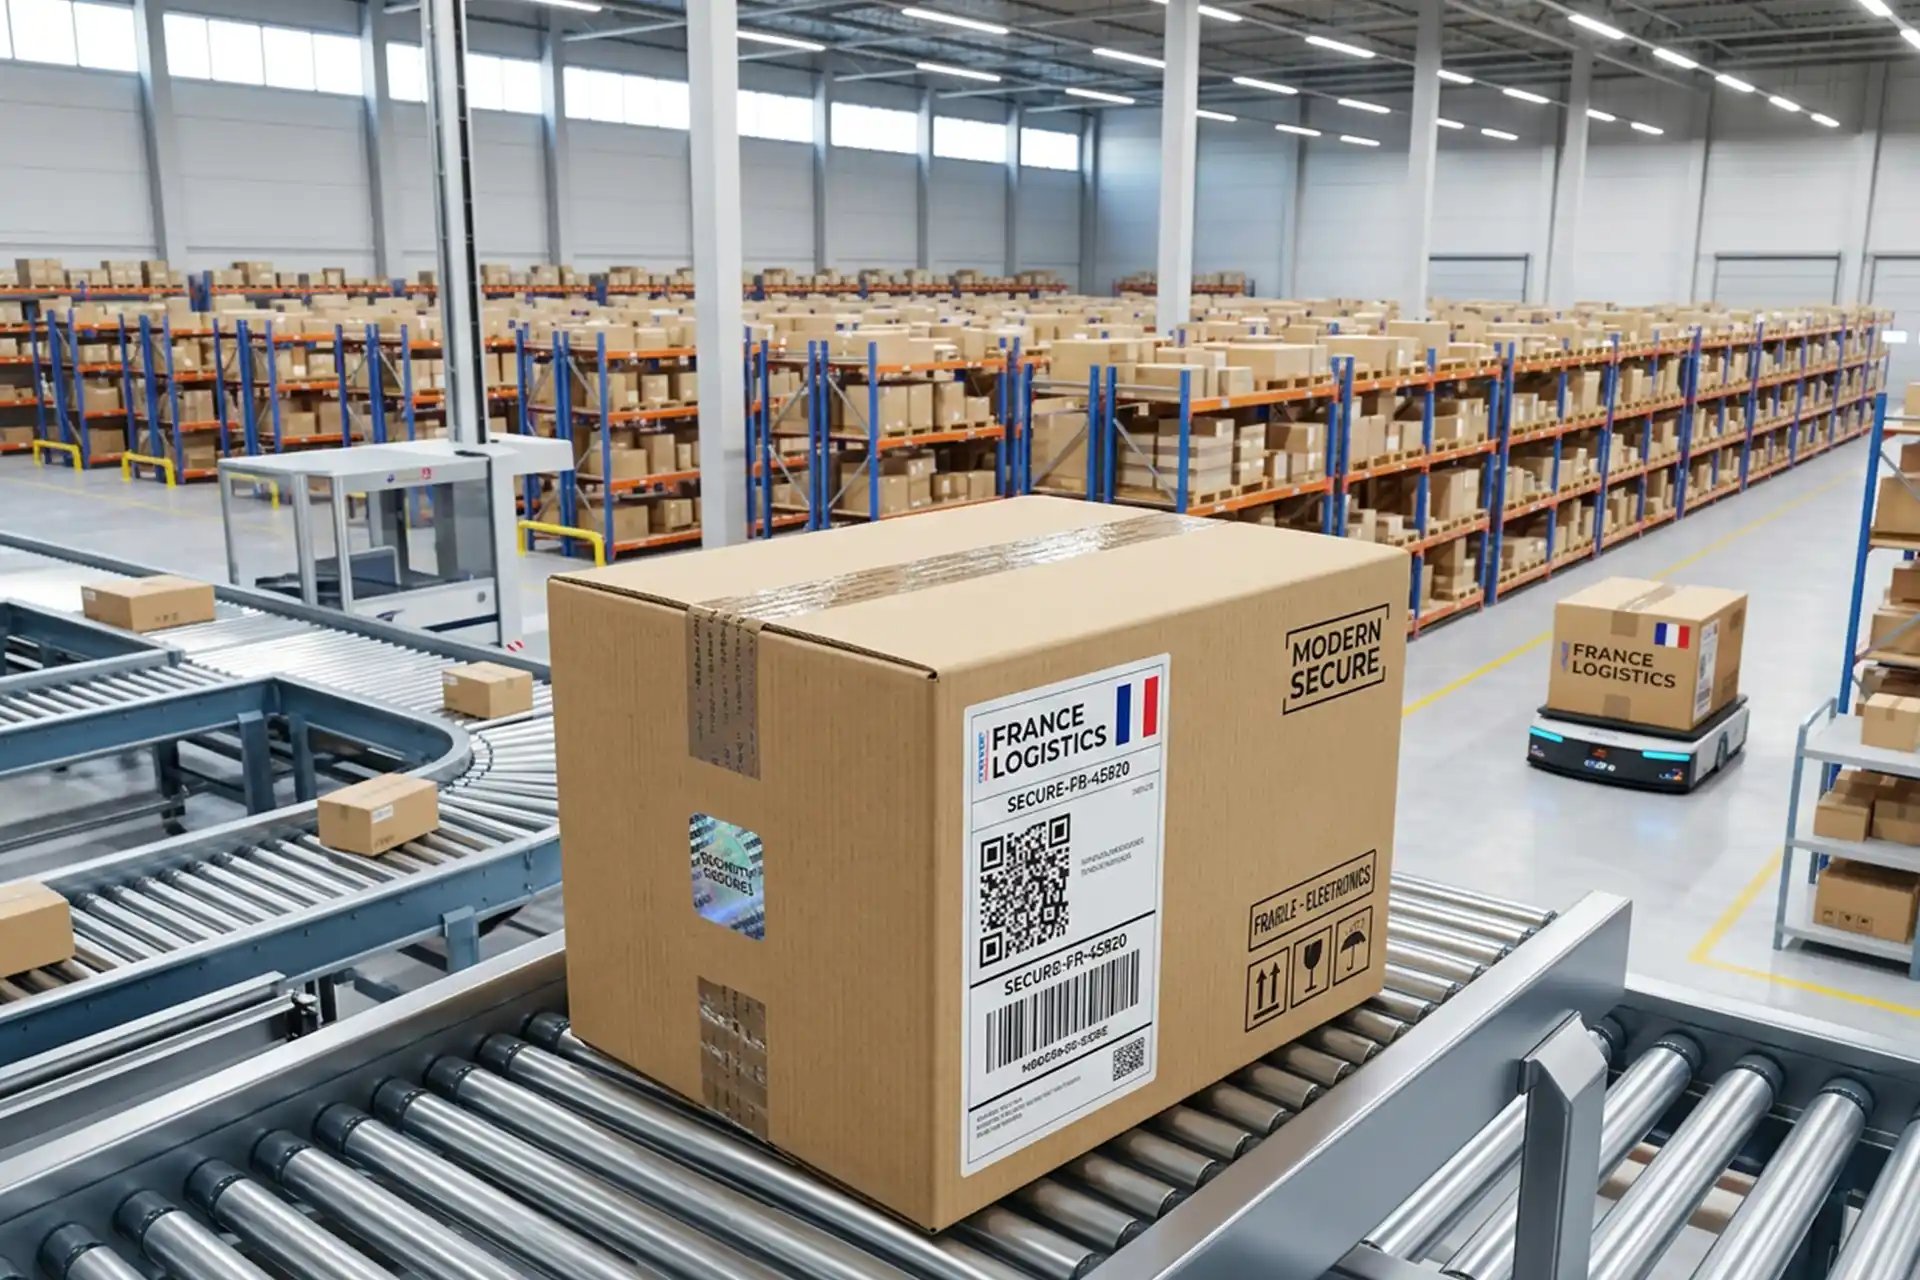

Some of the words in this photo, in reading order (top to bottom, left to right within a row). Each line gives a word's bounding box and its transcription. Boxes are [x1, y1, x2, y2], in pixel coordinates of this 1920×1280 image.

[1292, 618, 1382, 667] MODERN
[1573, 643, 1654, 668] FRANCE
[1290, 646, 1380, 699] SECURE
[1572, 660, 1676, 689] LOGISTICS
[992, 703, 1085, 750] FRANCE
[992, 725, 1107, 778] LOGISTICS
